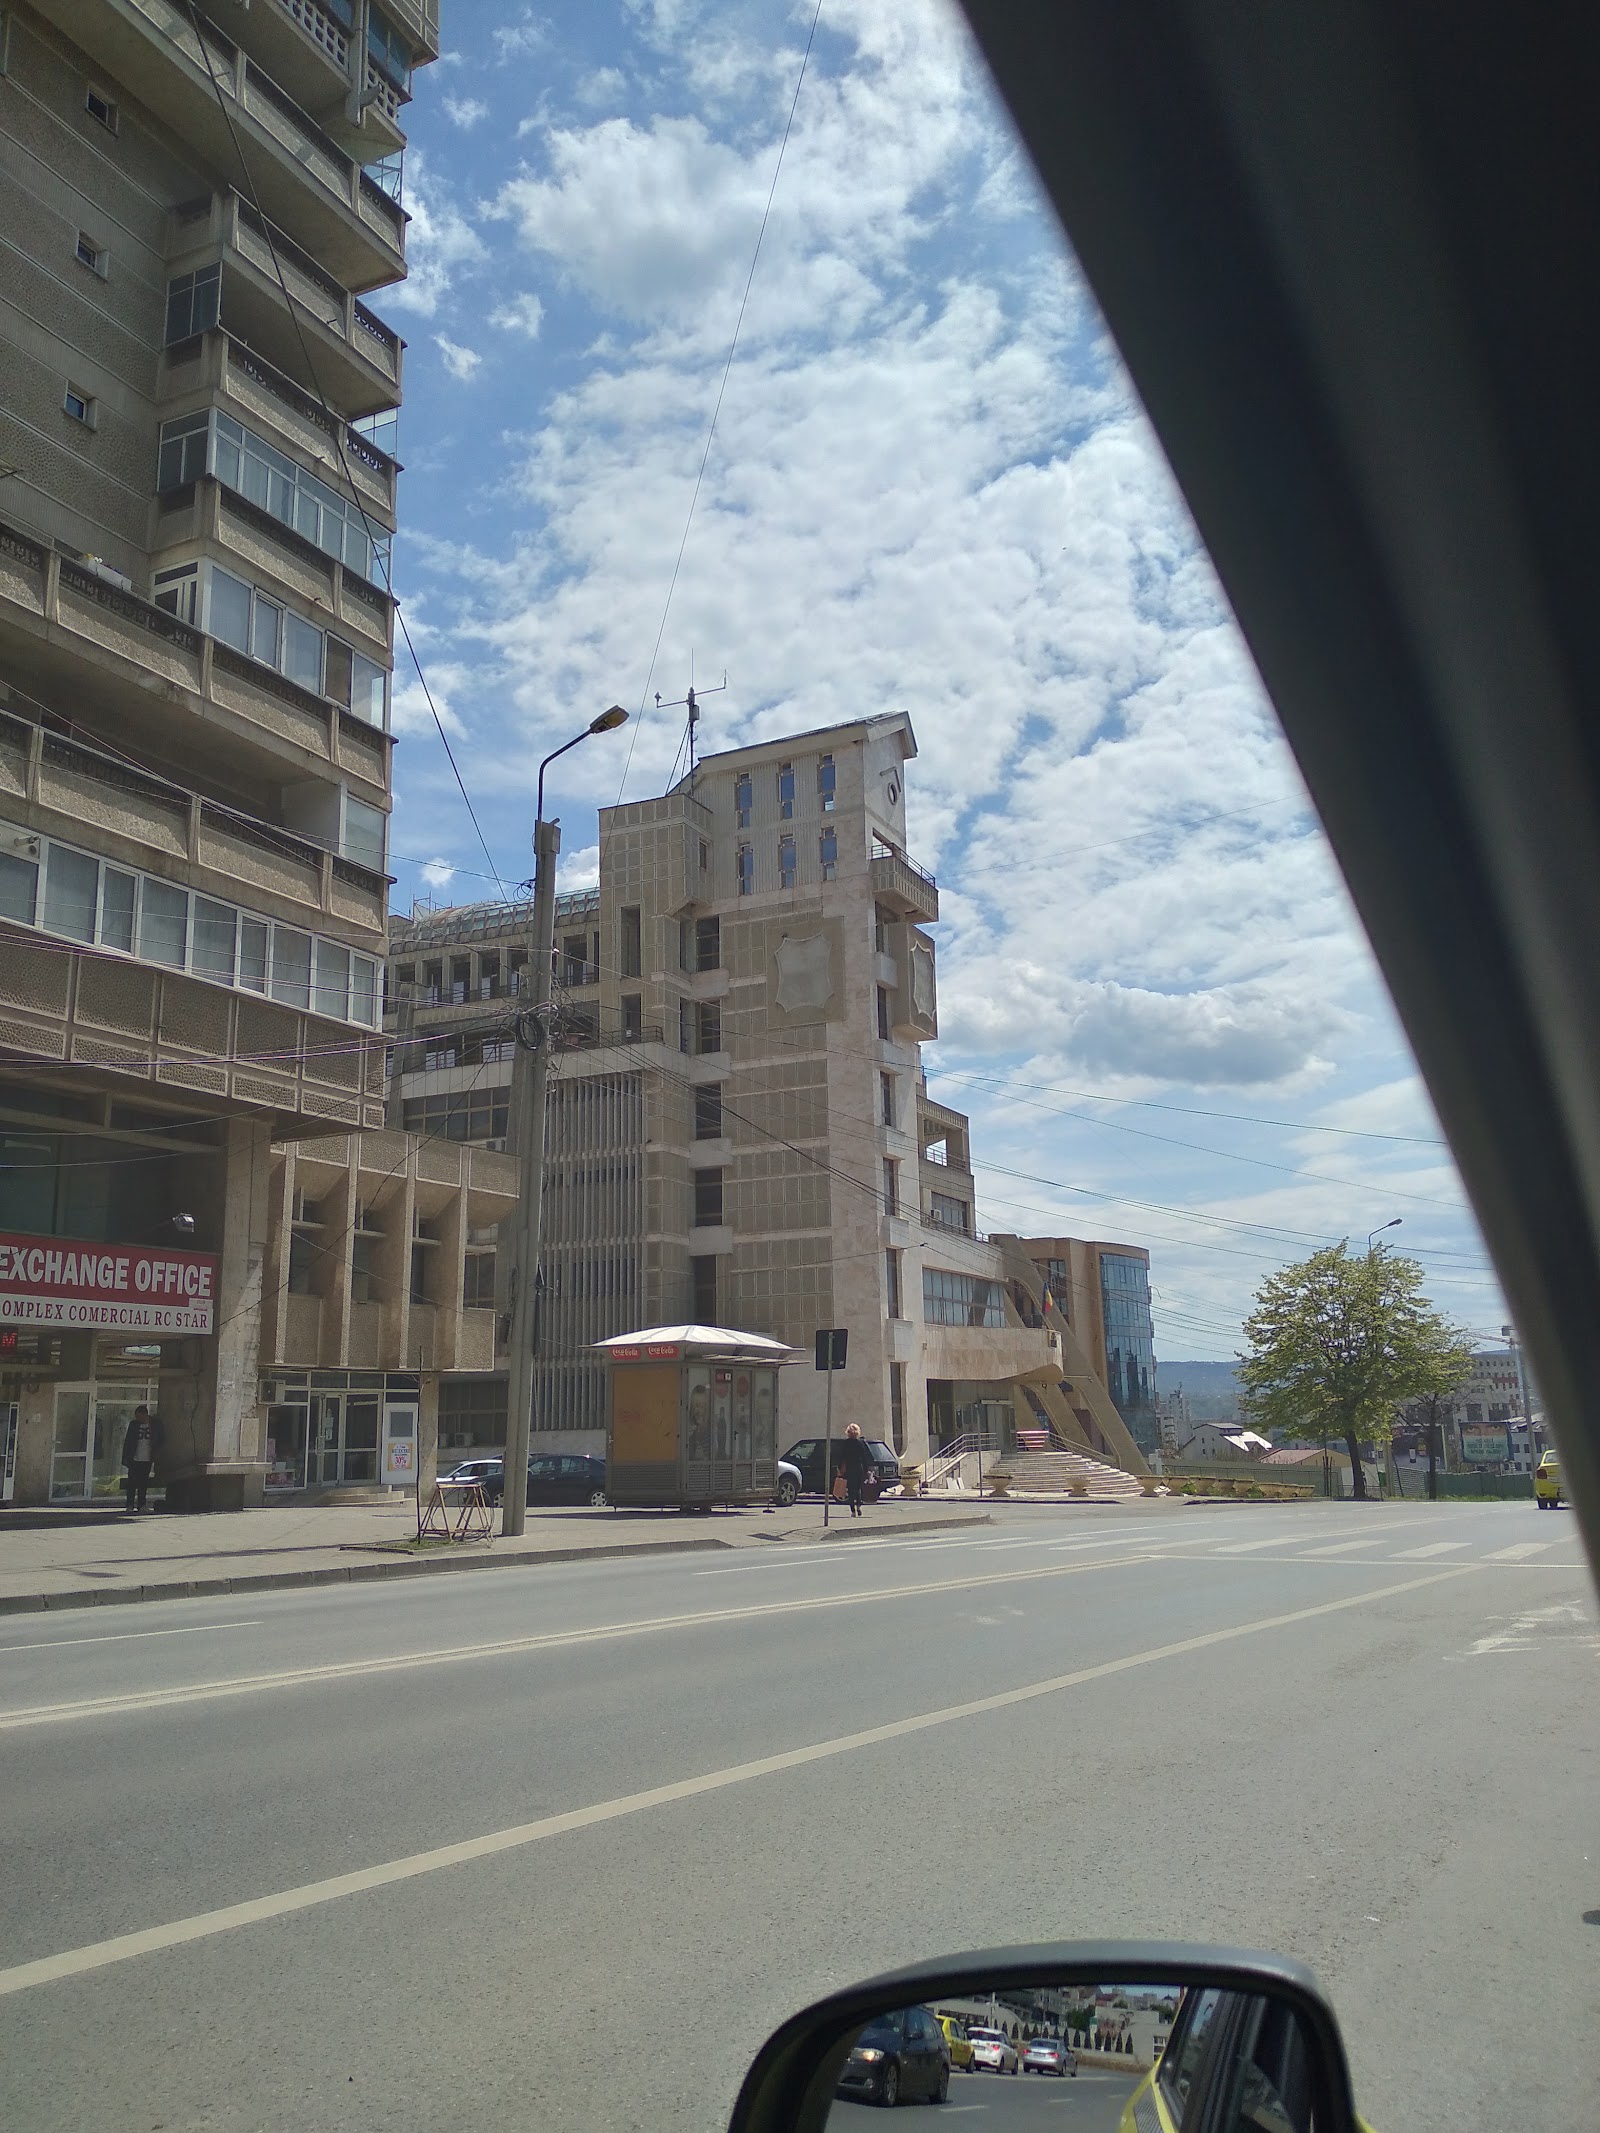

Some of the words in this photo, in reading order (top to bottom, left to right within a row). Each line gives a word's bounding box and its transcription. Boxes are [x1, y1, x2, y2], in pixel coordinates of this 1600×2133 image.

[0, 1245, 130, 1290] EXCHANGE
[134, 1259, 212, 1297] OFFICE
[69, 1305, 150, 1326] COMERCIAL
[154, 1311, 171, 1326] RC
[175, 1312, 207, 1328] STAR
